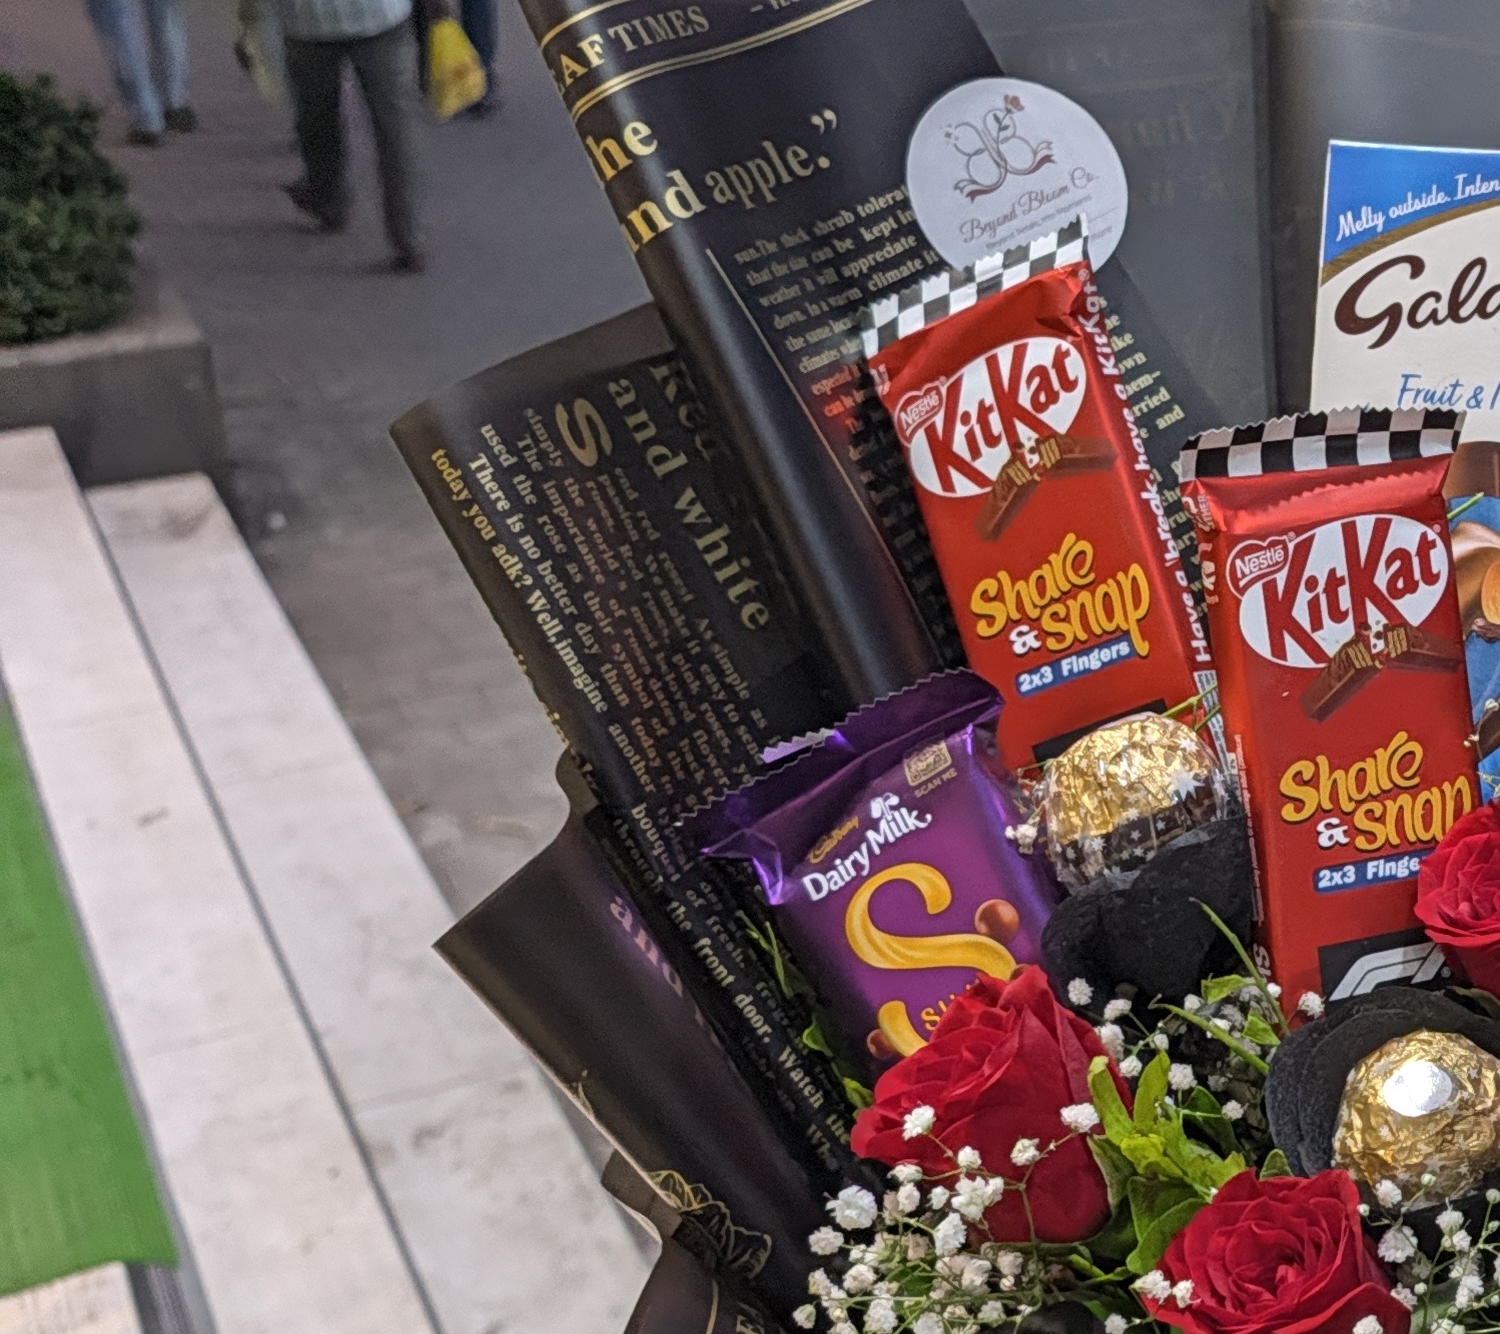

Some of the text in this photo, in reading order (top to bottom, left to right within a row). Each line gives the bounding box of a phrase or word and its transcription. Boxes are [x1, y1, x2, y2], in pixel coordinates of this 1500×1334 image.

[605, 5, 709, 51] TIMES
[858, 215, 898, 241] kept
[960, 201, 1018, 244] Beyond
[1336, 206, 1385, 241] Melty
[1389, 184, 1450, 219] outside.
[841, 235, 917, 277] appreciate
[867, 258, 924, 291] climate
[1155, 404, 1185, 430] and
[1397, 373, 1464, 407] Fruit
[1466, 387, 1486, 409] &
[526, 408, 584, 505] simply the
[1122, 405, 1151, 471] have
[516, 433, 627, 617] The importance of
[607, 378, 688, 478] and
[674, 486, 768, 629] white
[480, 423, 653, 709] used the rose as their symbol
[970, 533, 1094, 638] Share
[430, 448, 472, 500] today
[461, 503, 496, 540] you
[491, 543, 533, 588] adk?
[607, 723, 656, 792] another
[468, 452, 660, 766] There is no better day than today
[1180, 581, 1213, 664] Have
[1010, 623, 1043, 656] &
[1018, 642, 1130, 694] 2x3 Fingers
[699, 663, 738, 722] easy to
[710, 643, 750, 699] simple
[1280, 731, 1425, 823] Share
[801, 806, 932, 901] Dairy Milk
[1315, 817, 1350, 850] &
[686, 890, 707, 907] of
[1317, 865, 1357, 889] 2x3
[666, 901, 823, 1108] the front door. Watch
